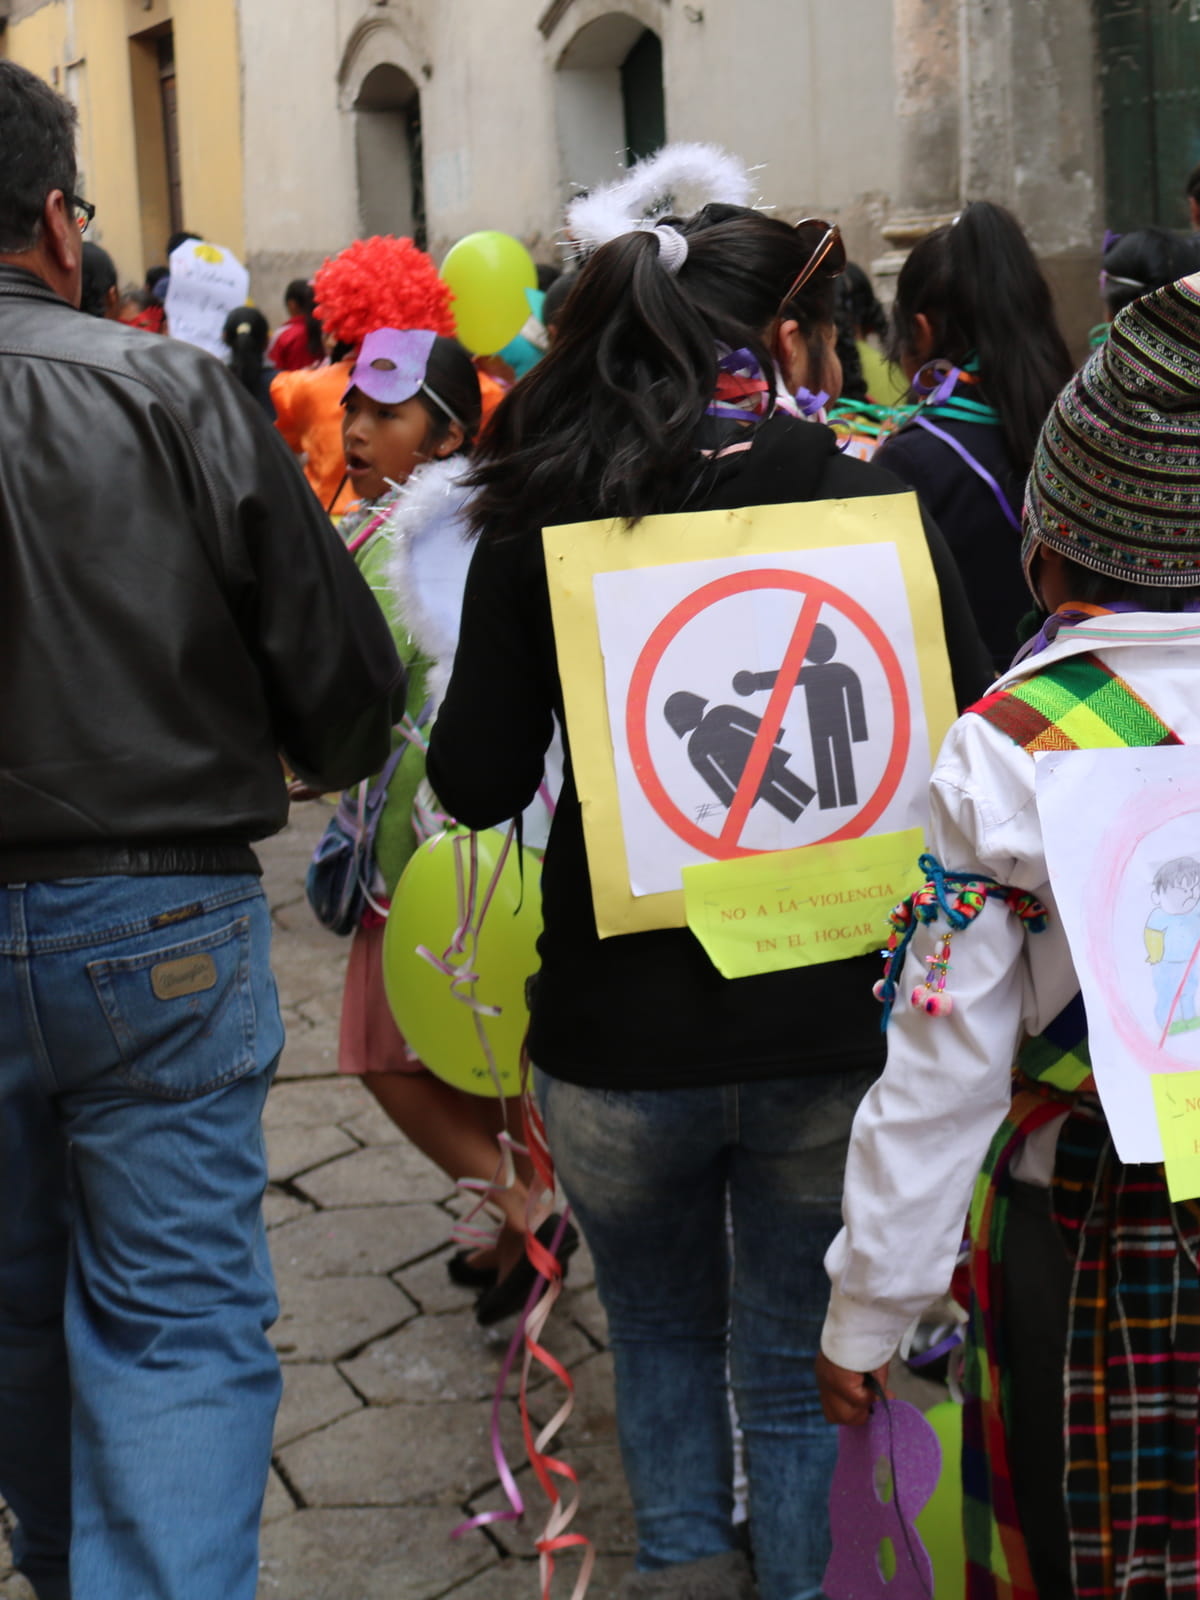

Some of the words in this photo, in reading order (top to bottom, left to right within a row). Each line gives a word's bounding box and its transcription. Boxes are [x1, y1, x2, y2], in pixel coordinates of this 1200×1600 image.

[720, 907, 748, 923] NO
[756, 904, 769, 918] A
[778, 900, 800, 915] LA
[808, 883, 896, 908] VIOLENCIA
[756, 938, 778, 954] EN
[788, 934, 807, 948] EL
[814, 922, 874, 945] HOGAR
